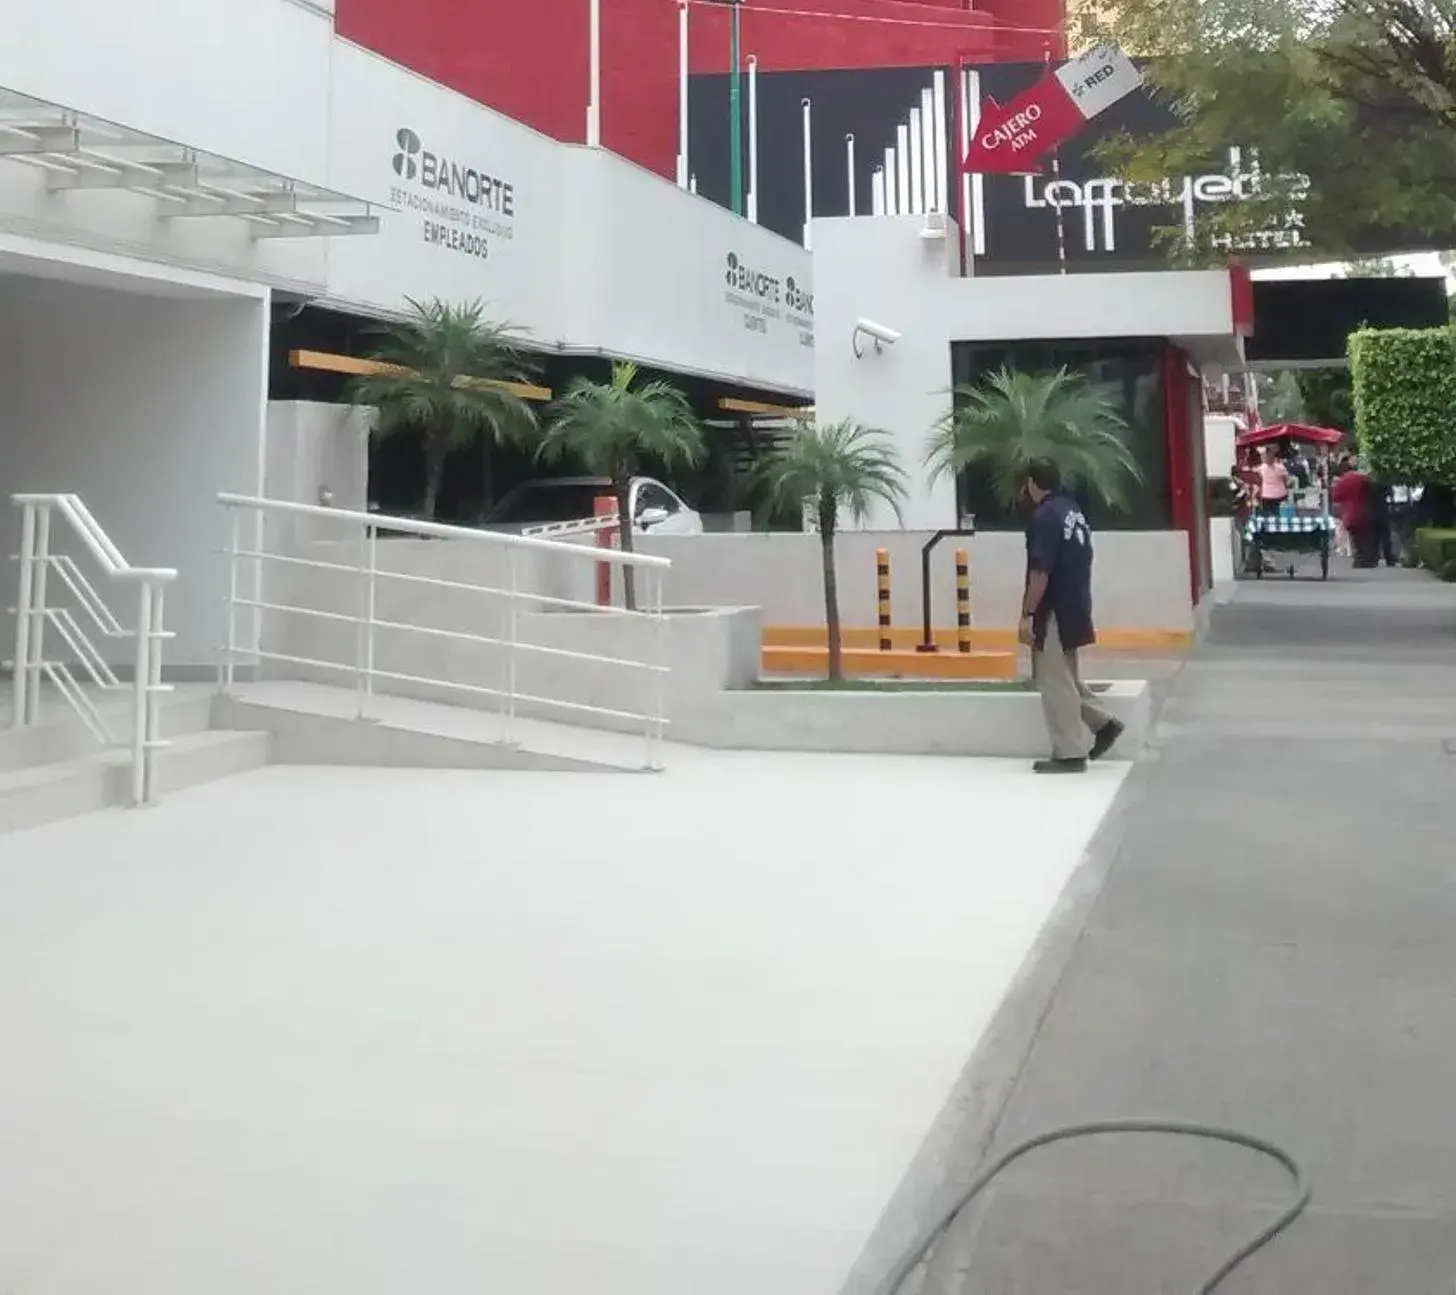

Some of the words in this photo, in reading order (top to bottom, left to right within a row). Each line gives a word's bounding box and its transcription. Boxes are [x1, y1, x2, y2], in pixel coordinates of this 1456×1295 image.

[1083, 64, 1115, 89] RED
[981, 103, 1042, 150] CAJERO
[1010, 128, 1038, 153] ATM
[421, 150, 514, 217] BANORTE
[423, 220, 488, 259] EMPLEADOS
[739, 265, 779, 303] BANORTE
